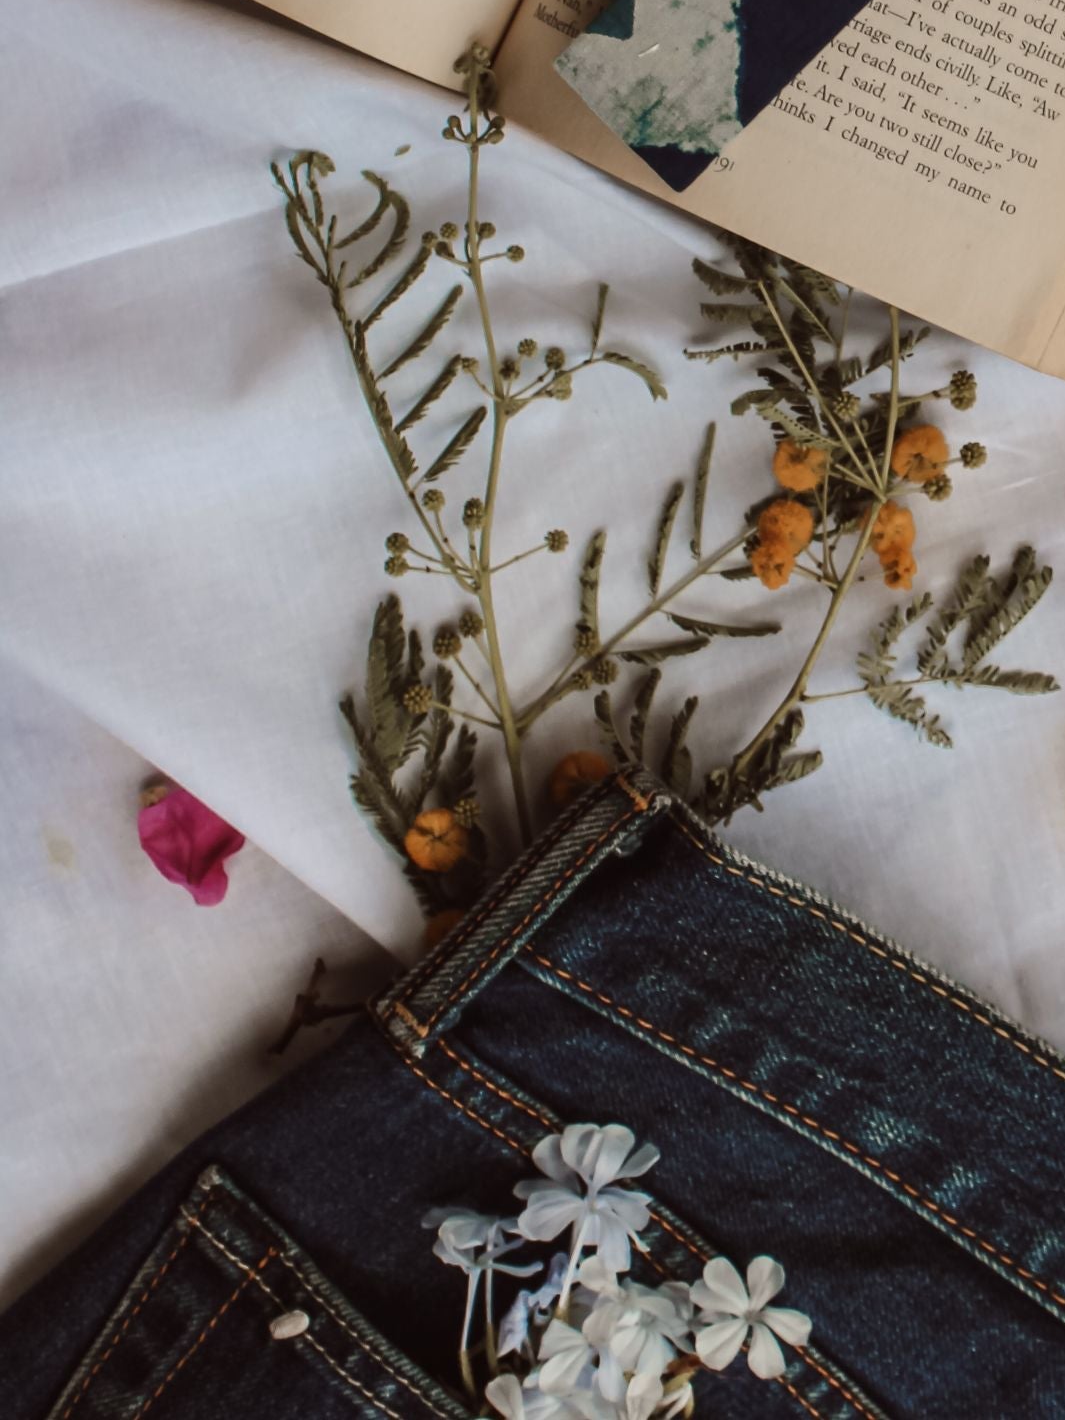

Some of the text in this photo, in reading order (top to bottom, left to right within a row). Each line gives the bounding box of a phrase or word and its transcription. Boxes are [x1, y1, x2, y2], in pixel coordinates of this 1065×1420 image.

[773, 94, 1016, 214] hinks I changed my name to
[813, 84, 843, 107] Are
[843, 102, 875, 123] you
[879, 116, 909, 137] two
[911, 133, 943, 152] still
[815, 55, 829, 74] it.
[837, 64, 849, 81] I
[851, 77, 886, 101] said,
[921, 109, 969, 136] seems
[974, 126, 1004, 153] like
[1006, 148, 1038, 169] you
